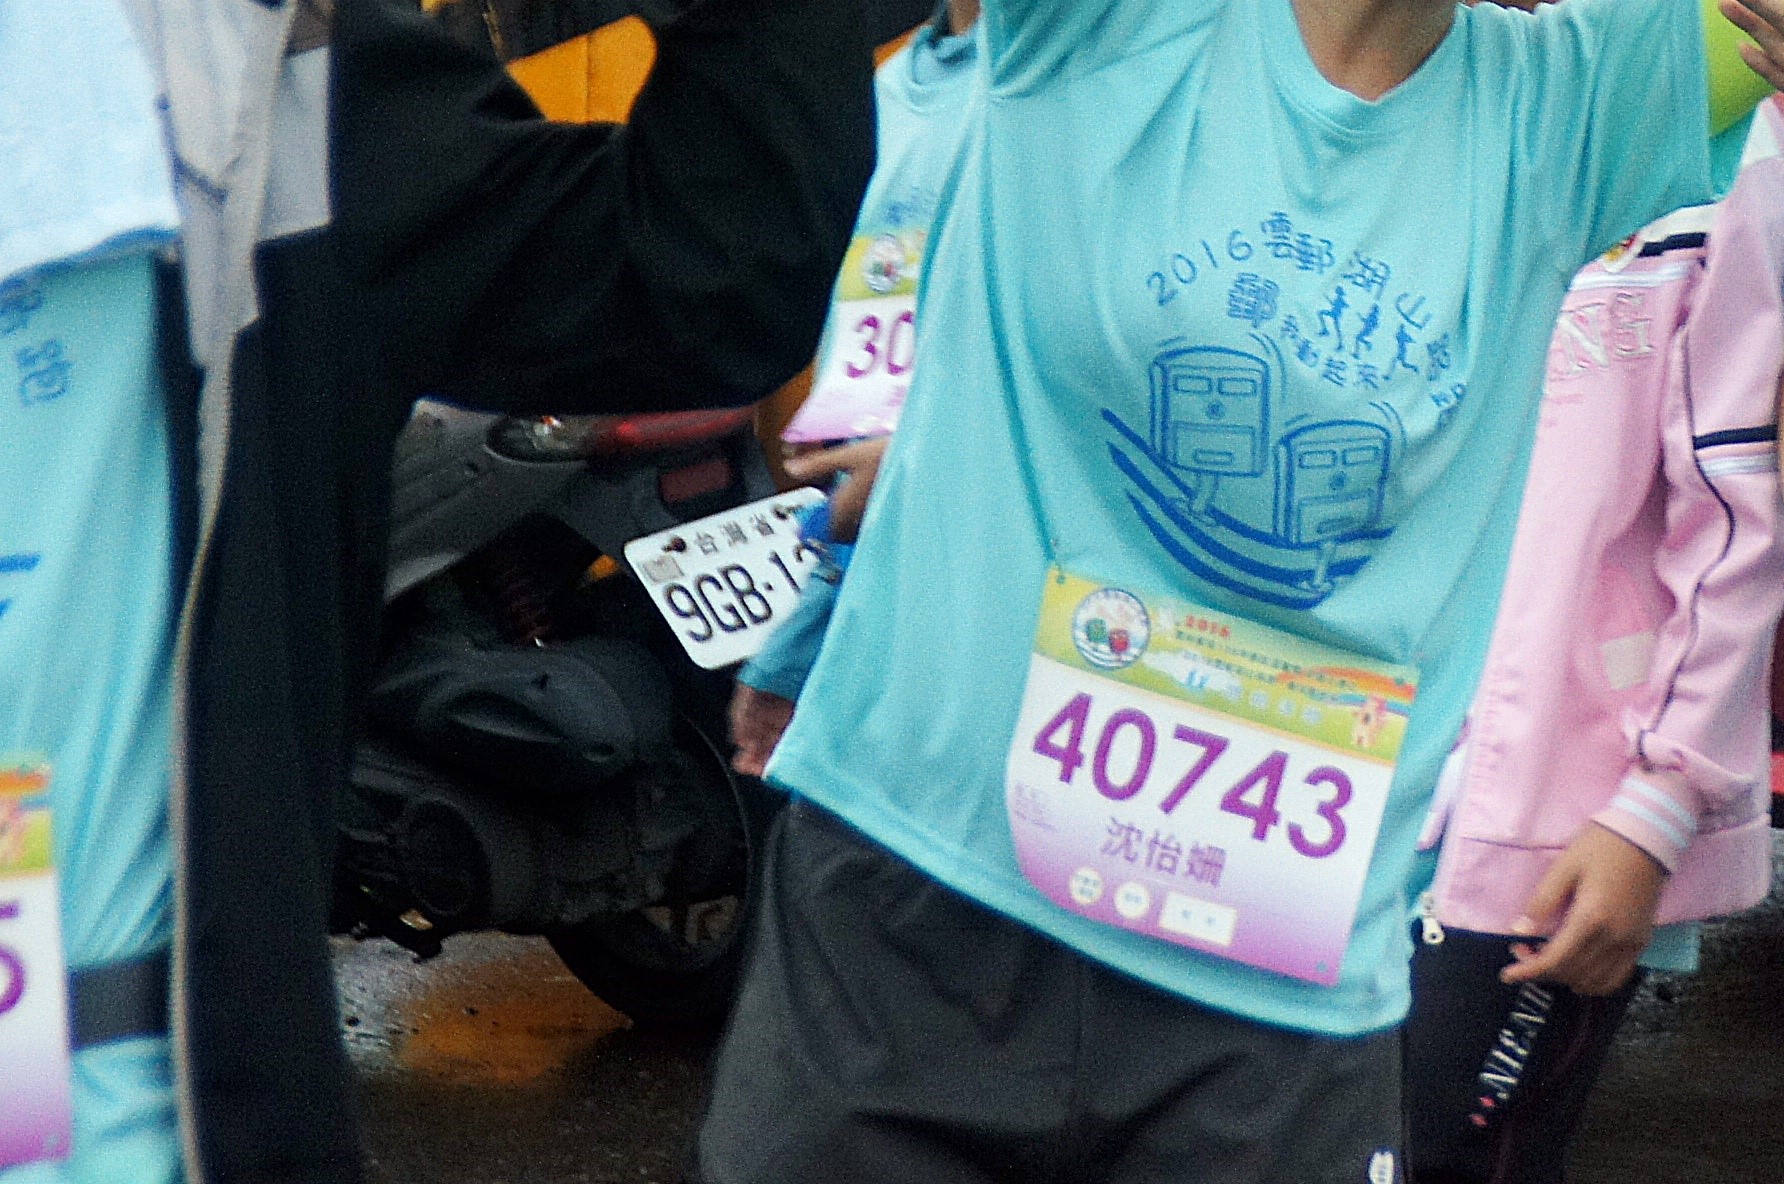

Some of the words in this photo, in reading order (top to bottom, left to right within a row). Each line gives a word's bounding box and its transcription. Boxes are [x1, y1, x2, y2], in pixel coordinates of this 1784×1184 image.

[693, 512, 776, 554] 台灣省
[1032, 691, 1354, 859] 40743
